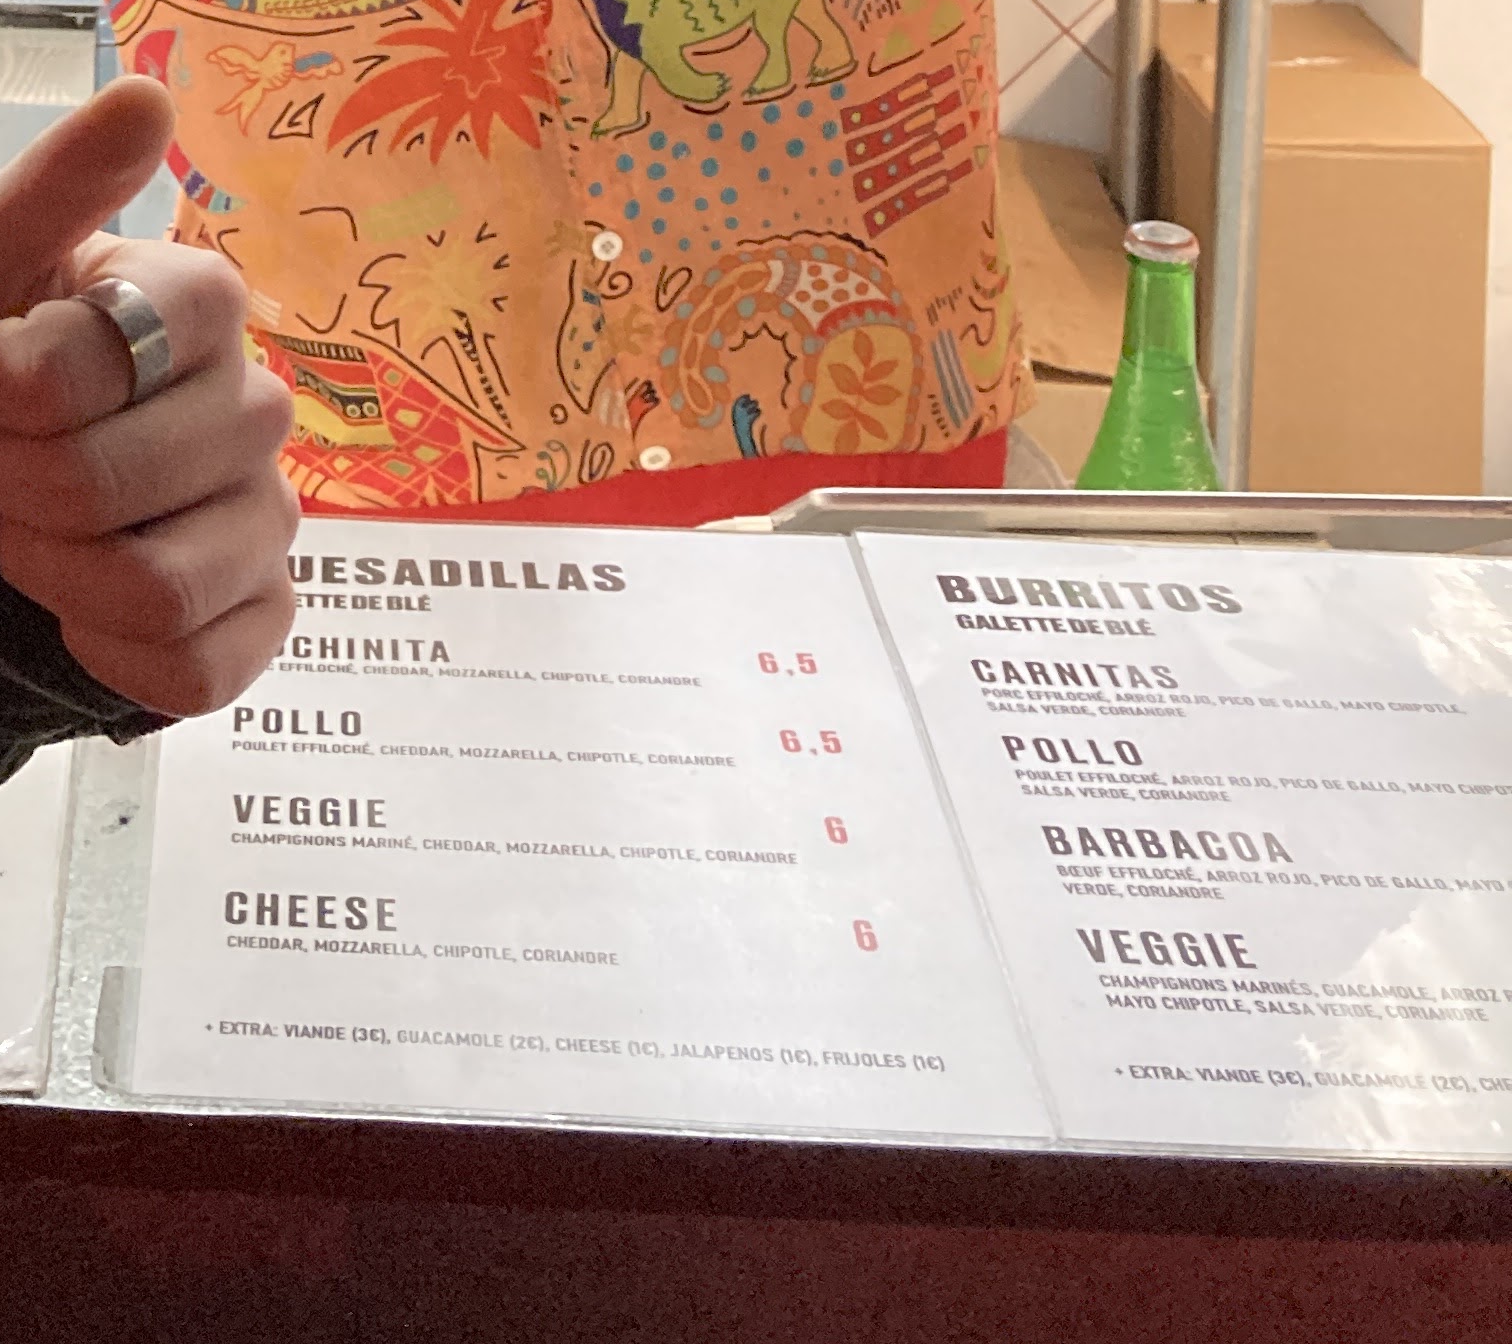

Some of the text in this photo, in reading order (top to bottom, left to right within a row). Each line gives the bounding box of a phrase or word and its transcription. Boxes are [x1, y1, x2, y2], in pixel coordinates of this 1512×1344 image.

[288, 555, 626, 592] UESADILLAS
[296, 593, 346, 609] ETTE
[936, 574, 1244, 614] BURRITOS
[279, 635, 450, 662] CHINITA
[363, 664, 434, 678] CHEDDAR,
[438, 667, 537, 682] MOZZARELLA,
[541, 670, 615, 685] CHIPOTLE,
[618, 674, 703, 688] CORIANDRE
[757, 652, 818, 676] 6,5
[971, 659, 1179, 690] CARNITAS
[981, 687, 1024, 701] PORC
[1115, 692, 1167, 705] ARROZ
[1172, 694, 1216, 707] ROJO,
[1218, 695, 1255, 707] PICO
[1259, 696, 1280, 708] DE
[1283, 698, 1339, 711] GALLO,
[1340, 700, 1385, 712] MAYO
[987, 700, 1187, 718] SALSA VERDE, CORIANDRE
[234, 706, 362, 736] POLLO
[232, 740, 736, 768] POULET EFFILOCHÉ, CHEDDAR, MOZZARELLA, CHIPOTLE, CORIANDRE
[779, 729, 843, 756] 6,5
[1002, 735, 1144, 766] POLLO
[1015, 770, 1073, 783] POULET
[1172, 774, 1225, 787] ARROZ
[1228, 776, 1278, 790] ROJO,
[1279, 777, 1318, 790] PICO
[1321, 779, 1344, 791] DE
[1346, 780, 1407, 795] GALLO,
[1408, 782, 1454, 795] MAYO
[1021, 784, 1232, 803] SALSA VERDE, CORIANDRE
[233, 794, 387, 828] VEGGIE
[823, 816, 849, 845] 6
[1042, 824, 1294, 864] BARBACOA
[231, 832, 799, 865] CHAMPIGNONS MARINÉ, CHEDDAR, MOZZARELLA, CHIPOTLE, CORIANDRE
[1056, 864, 1103, 879] BŒUF
[1109, 866, 1202, 883] EFFILOCHÉ,
[1207, 870, 1263, 885] ARROZ
[1267, 872, 1319, 887] ROJO,
[1320, 873, 1361, 888] PICO
[1364, 875, 1389, 888] DE
[1392, 876, 1454, 892] GALLO,
[1455, 879, 1505, 892] MAYO
[1063, 883, 1225, 901] VERDE, CORIANDRE
[224, 891, 398, 932] CHEESE
[852, 919, 879, 952] 6
[1076, 928, 1258, 970] VEGGIE
[227, 935, 620, 966] CHEDDAR, MOZZARELLA, CHIPOTLE, CORIANDRE
[1099, 974, 1228, 992] CHAMPIGNONS
[1232, 978, 1319, 998] MARINÉS,
[1321, 983, 1437, 1003] GUACAMOLE,
[1441, 987, 1502, 1003] ARROZ
[1105, 994, 1490, 1022] MAYO CHIPOTLE, SALSA VERDE, CORIANDRE
[219, 1021, 279, 1037] EXTRA:
[283, 1023, 347, 1041] VIANDE
[351, 1026, 392, 1045] (3€),
[397, 1029, 504, 1049] GUACAMOLE
[509, 1033, 551, 1053] (2€),
[554, 1037, 621, 1055] CHEESE
[671, 1043, 775, 1063] JALAPENOS
[822, 1050, 907, 1069] FRIJOLES
[913, 1055, 946, 1073] (1€)
[1128, 1064, 1192, 1081] EXTRA:
[1195, 1067, 1264, 1084] VIANDE
[1314, 1071, 1428, 1089] GUACAMOLE
